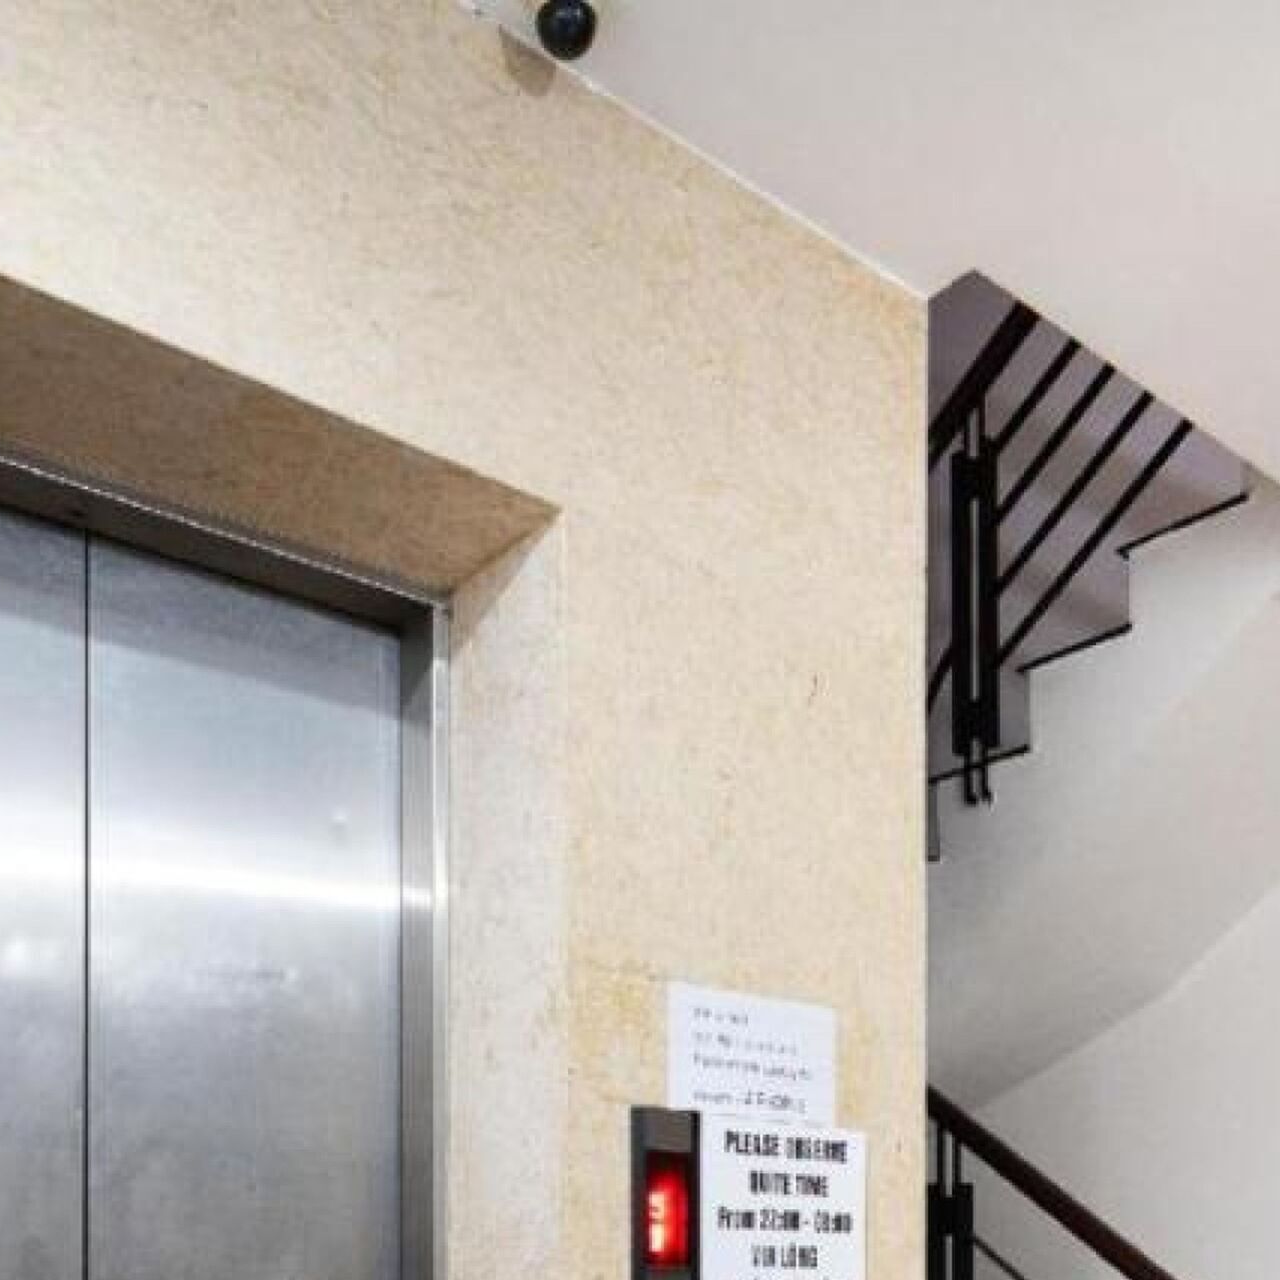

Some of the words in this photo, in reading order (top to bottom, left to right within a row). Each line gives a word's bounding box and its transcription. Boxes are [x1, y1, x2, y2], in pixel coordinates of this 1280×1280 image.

[724, 1130, 779, 1156] PLEASE
[785, 1136, 848, 1164] OBSERVE
[795, 1174, 829, 1197] TIME
[718, 1206, 755, 1231] From
